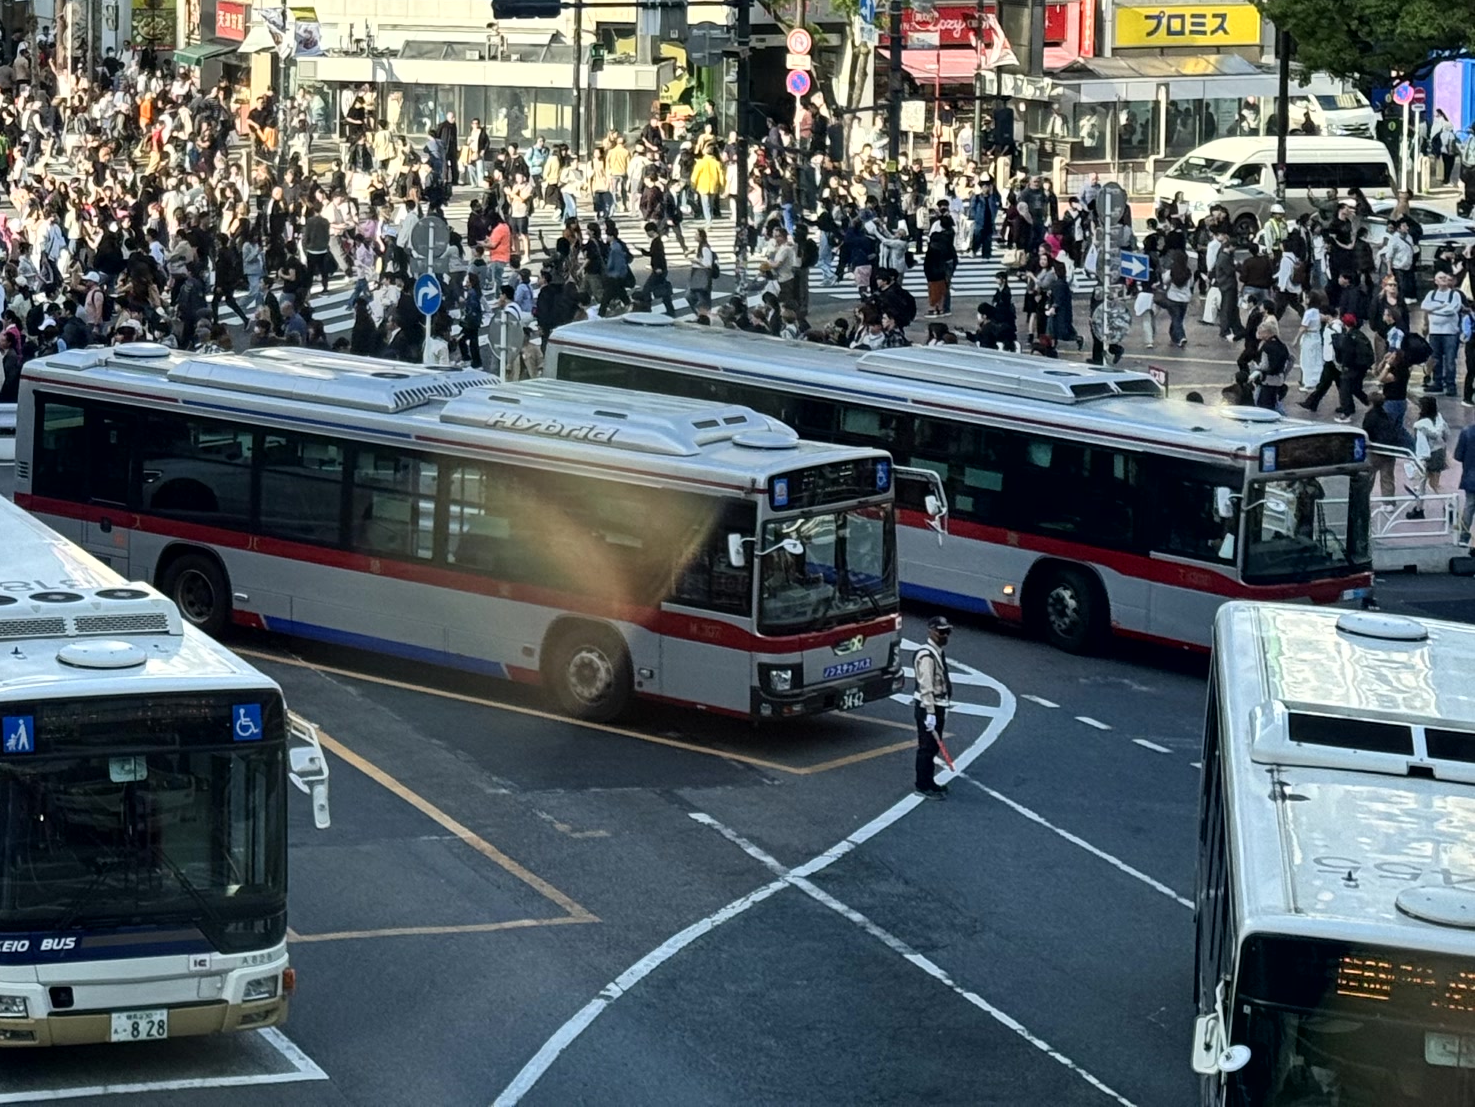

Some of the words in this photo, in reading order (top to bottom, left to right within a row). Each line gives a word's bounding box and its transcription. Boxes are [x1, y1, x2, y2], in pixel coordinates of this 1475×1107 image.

[1144, 10, 1230, 38] プロミス
[485, 410, 620, 444] Hybrid
[824, 657, 872, 678] ノンステップバス
[40, 936, 77, 953] BUS
[131, 1018, 166, 1040] 828
